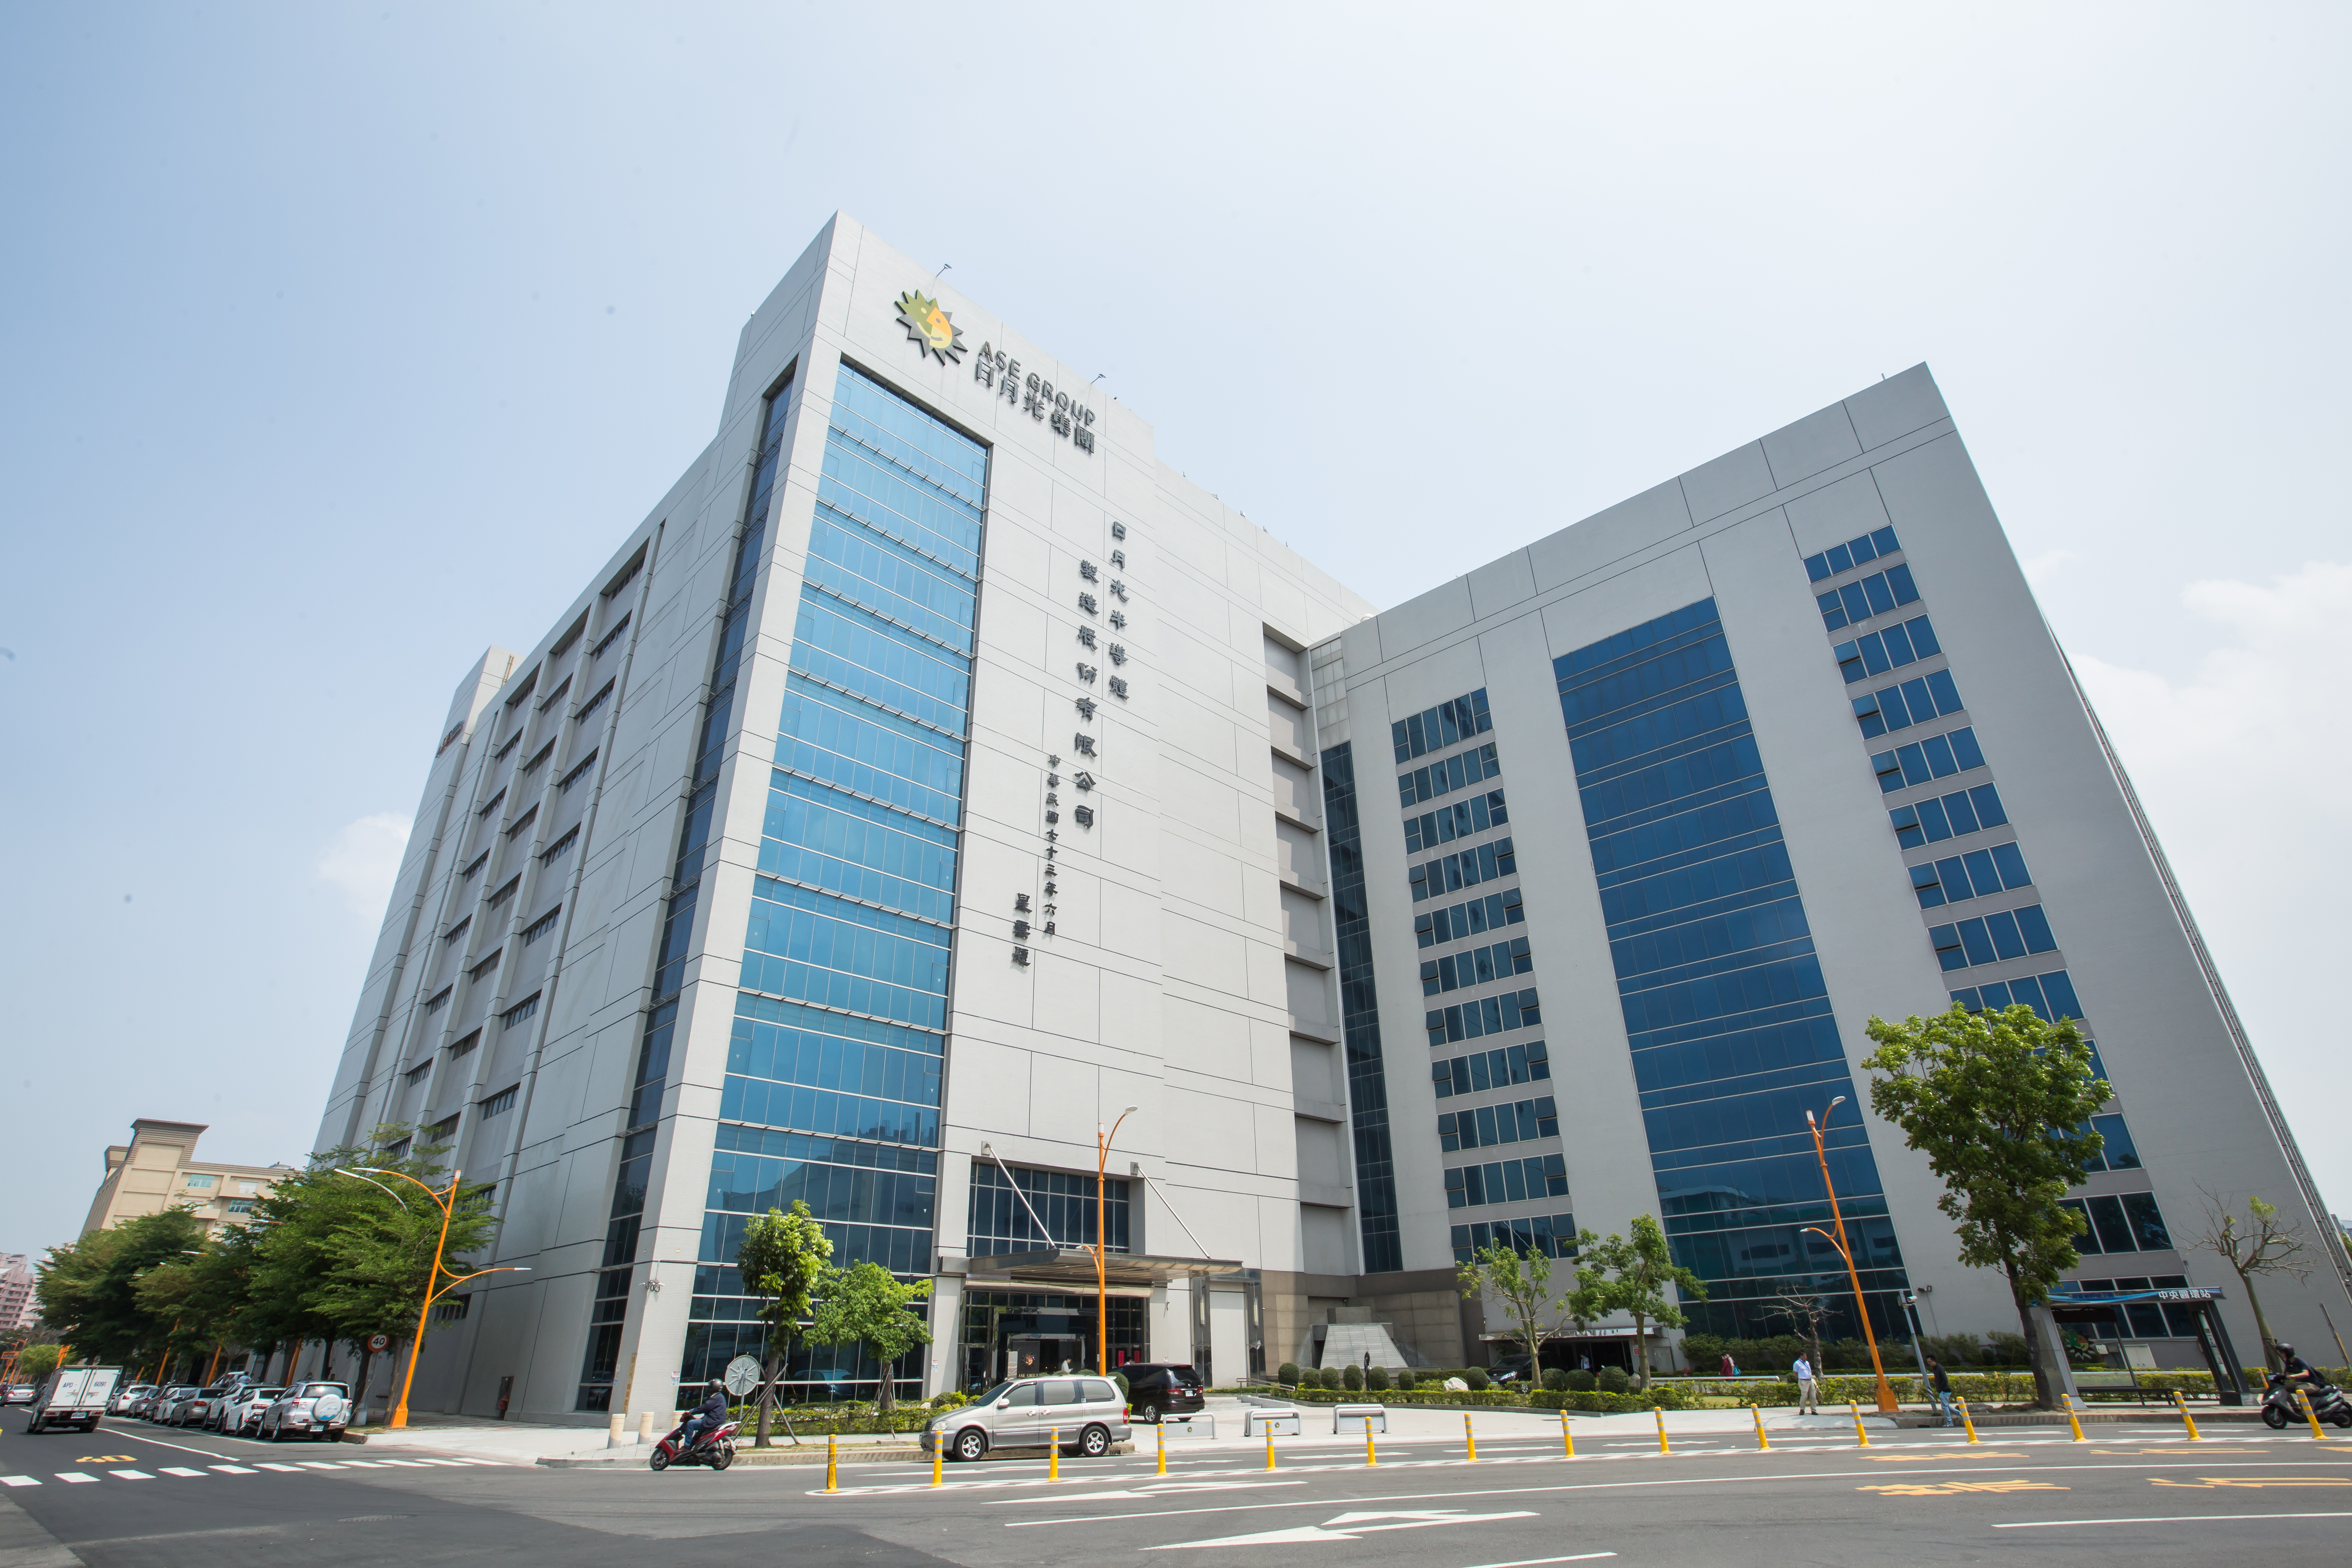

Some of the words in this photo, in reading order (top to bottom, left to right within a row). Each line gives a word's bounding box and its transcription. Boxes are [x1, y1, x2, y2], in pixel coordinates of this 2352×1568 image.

[976, 358, 1095, 454] 日月光集團
[979, 341, 1021, 381] ASE
[1027, 372, 1096, 426] GROUP
[1109, 521, 1130, 700] 日月光半導體
[1074, 559, 1100, 829] 製造股份有限公司
[1042, 754, 1061, 936] 中華民國七十三年六月
[372, 1337, 385, 1345] 40
[75, 1455, 138, 1463] 40
